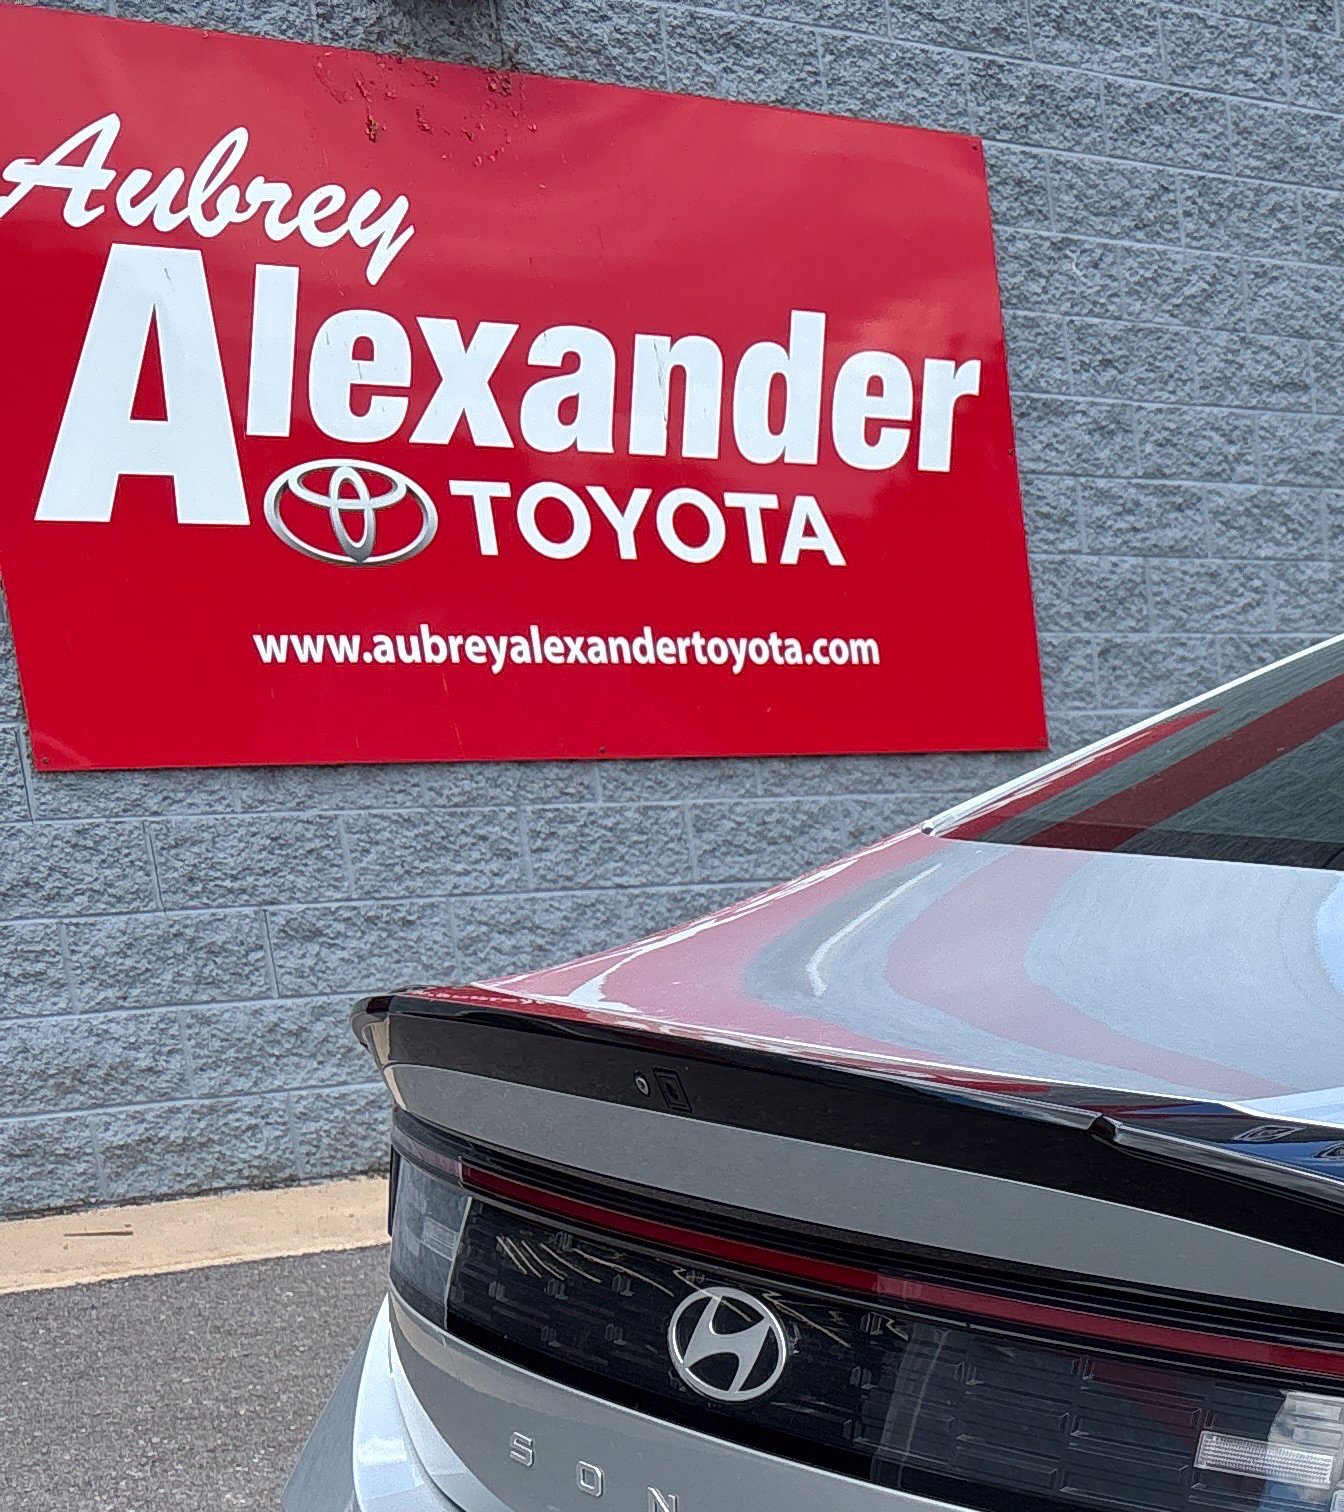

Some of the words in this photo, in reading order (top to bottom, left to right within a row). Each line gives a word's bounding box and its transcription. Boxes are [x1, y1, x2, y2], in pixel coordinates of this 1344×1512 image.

[0, 112, 416, 285] Aubrey
[34, 243, 982, 527] Alexander
[449, 479, 847, 567] TOYOTA
[253, 625, 881, 674] www.aubreyalexandertoyota.com
